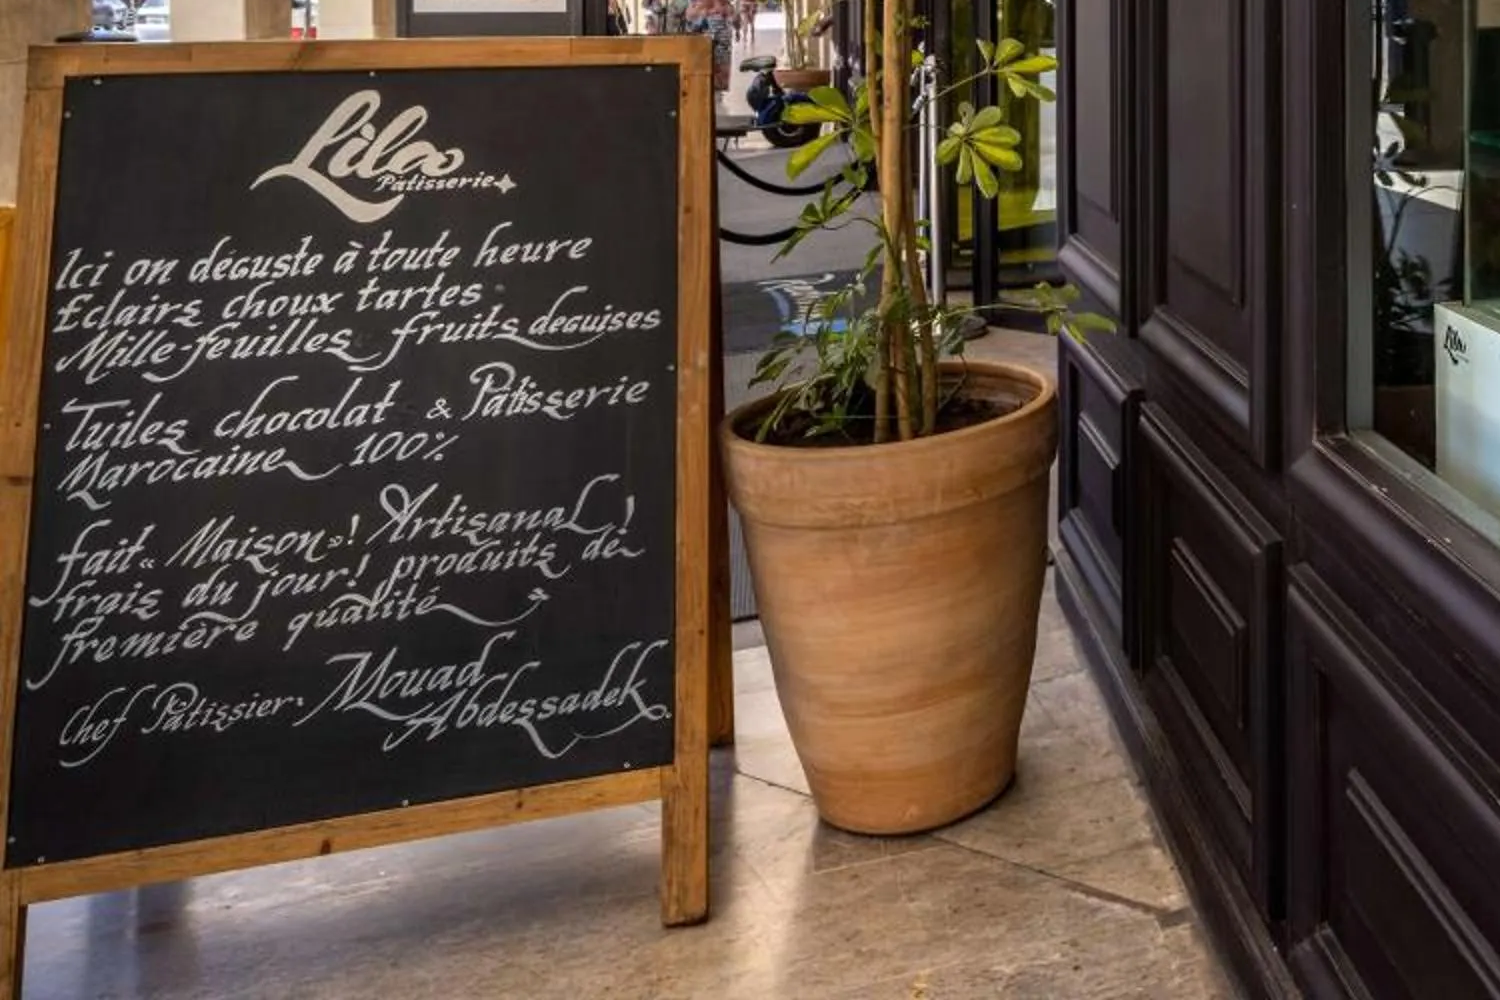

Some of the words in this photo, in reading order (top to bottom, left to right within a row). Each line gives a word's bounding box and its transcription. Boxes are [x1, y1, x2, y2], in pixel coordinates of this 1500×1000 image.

[250, 90, 465, 222] Lila
[55, 247, 114, 290] Ici
[123, 258, 179, 285] on
[367, 229, 461, 273] toute
[473, 221, 592, 267] heure
[53, 289, 203, 332] Eclairs
[221, 280, 344, 319] choux
[55, 318, 382, 385] Mille-feuilles
[348, 303, 522, 371] fruits
[61, 391, 201, 455] Tuiles
[213, 375, 403, 438] chocolat
[425, 397, 453, 419] &
[57, 445, 343, 511] Marocaine
[350, 431, 459, 466] 100%
[28, 518, 157, 607] fait
[53, 579, 164, 623] frais
[182, 564, 240, 608] du
[371, 540, 572, 602] produits
[580, 531, 646, 562] de
[59, 684, 158, 768] Chef
[292, 630, 516, 722] Mouad
